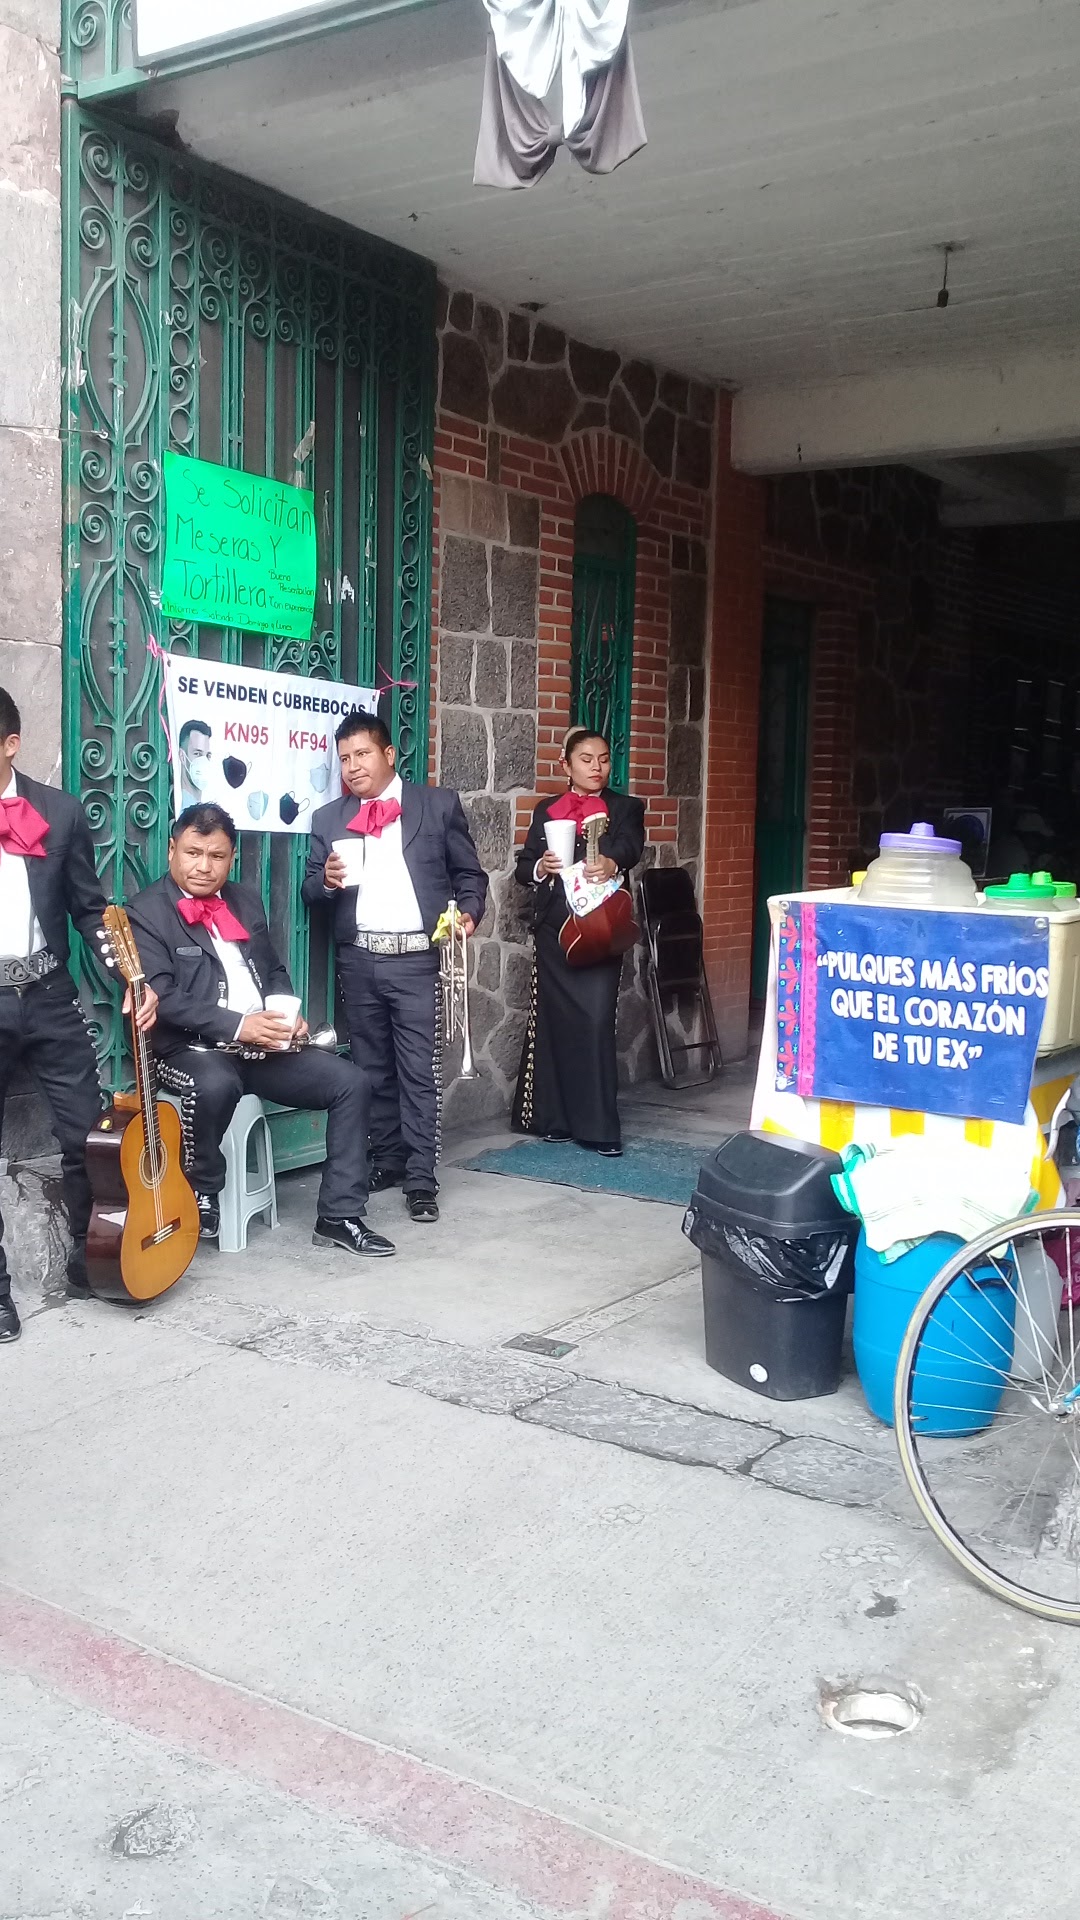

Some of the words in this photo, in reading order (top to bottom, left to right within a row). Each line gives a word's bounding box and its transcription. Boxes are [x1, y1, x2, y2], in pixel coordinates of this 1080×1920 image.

[183, 469, 210, 507] Se
[223, 479, 312, 536] Solicitan
[175, 514, 261, 562] Meseras
[173, 558, 267, 608] Tortillera
[177, 676, 199, 694] SE
[204, 680, 268, 705] VENDEN
[224, 721, 270, 746] KN95
[288, 729, 328, 753] KF94
[919, 956, 976, 993] MÁS
[980, 960, 1050, 999] FRÍOS
[830, 988, 873, 1020] QUE
[876, 993, 900, 1025] EL
[903, 995, 1026, 1036] CORAZÓN
[872, 1031, 899, 1062] DE
[903, 1034, 933, 1065] TU
